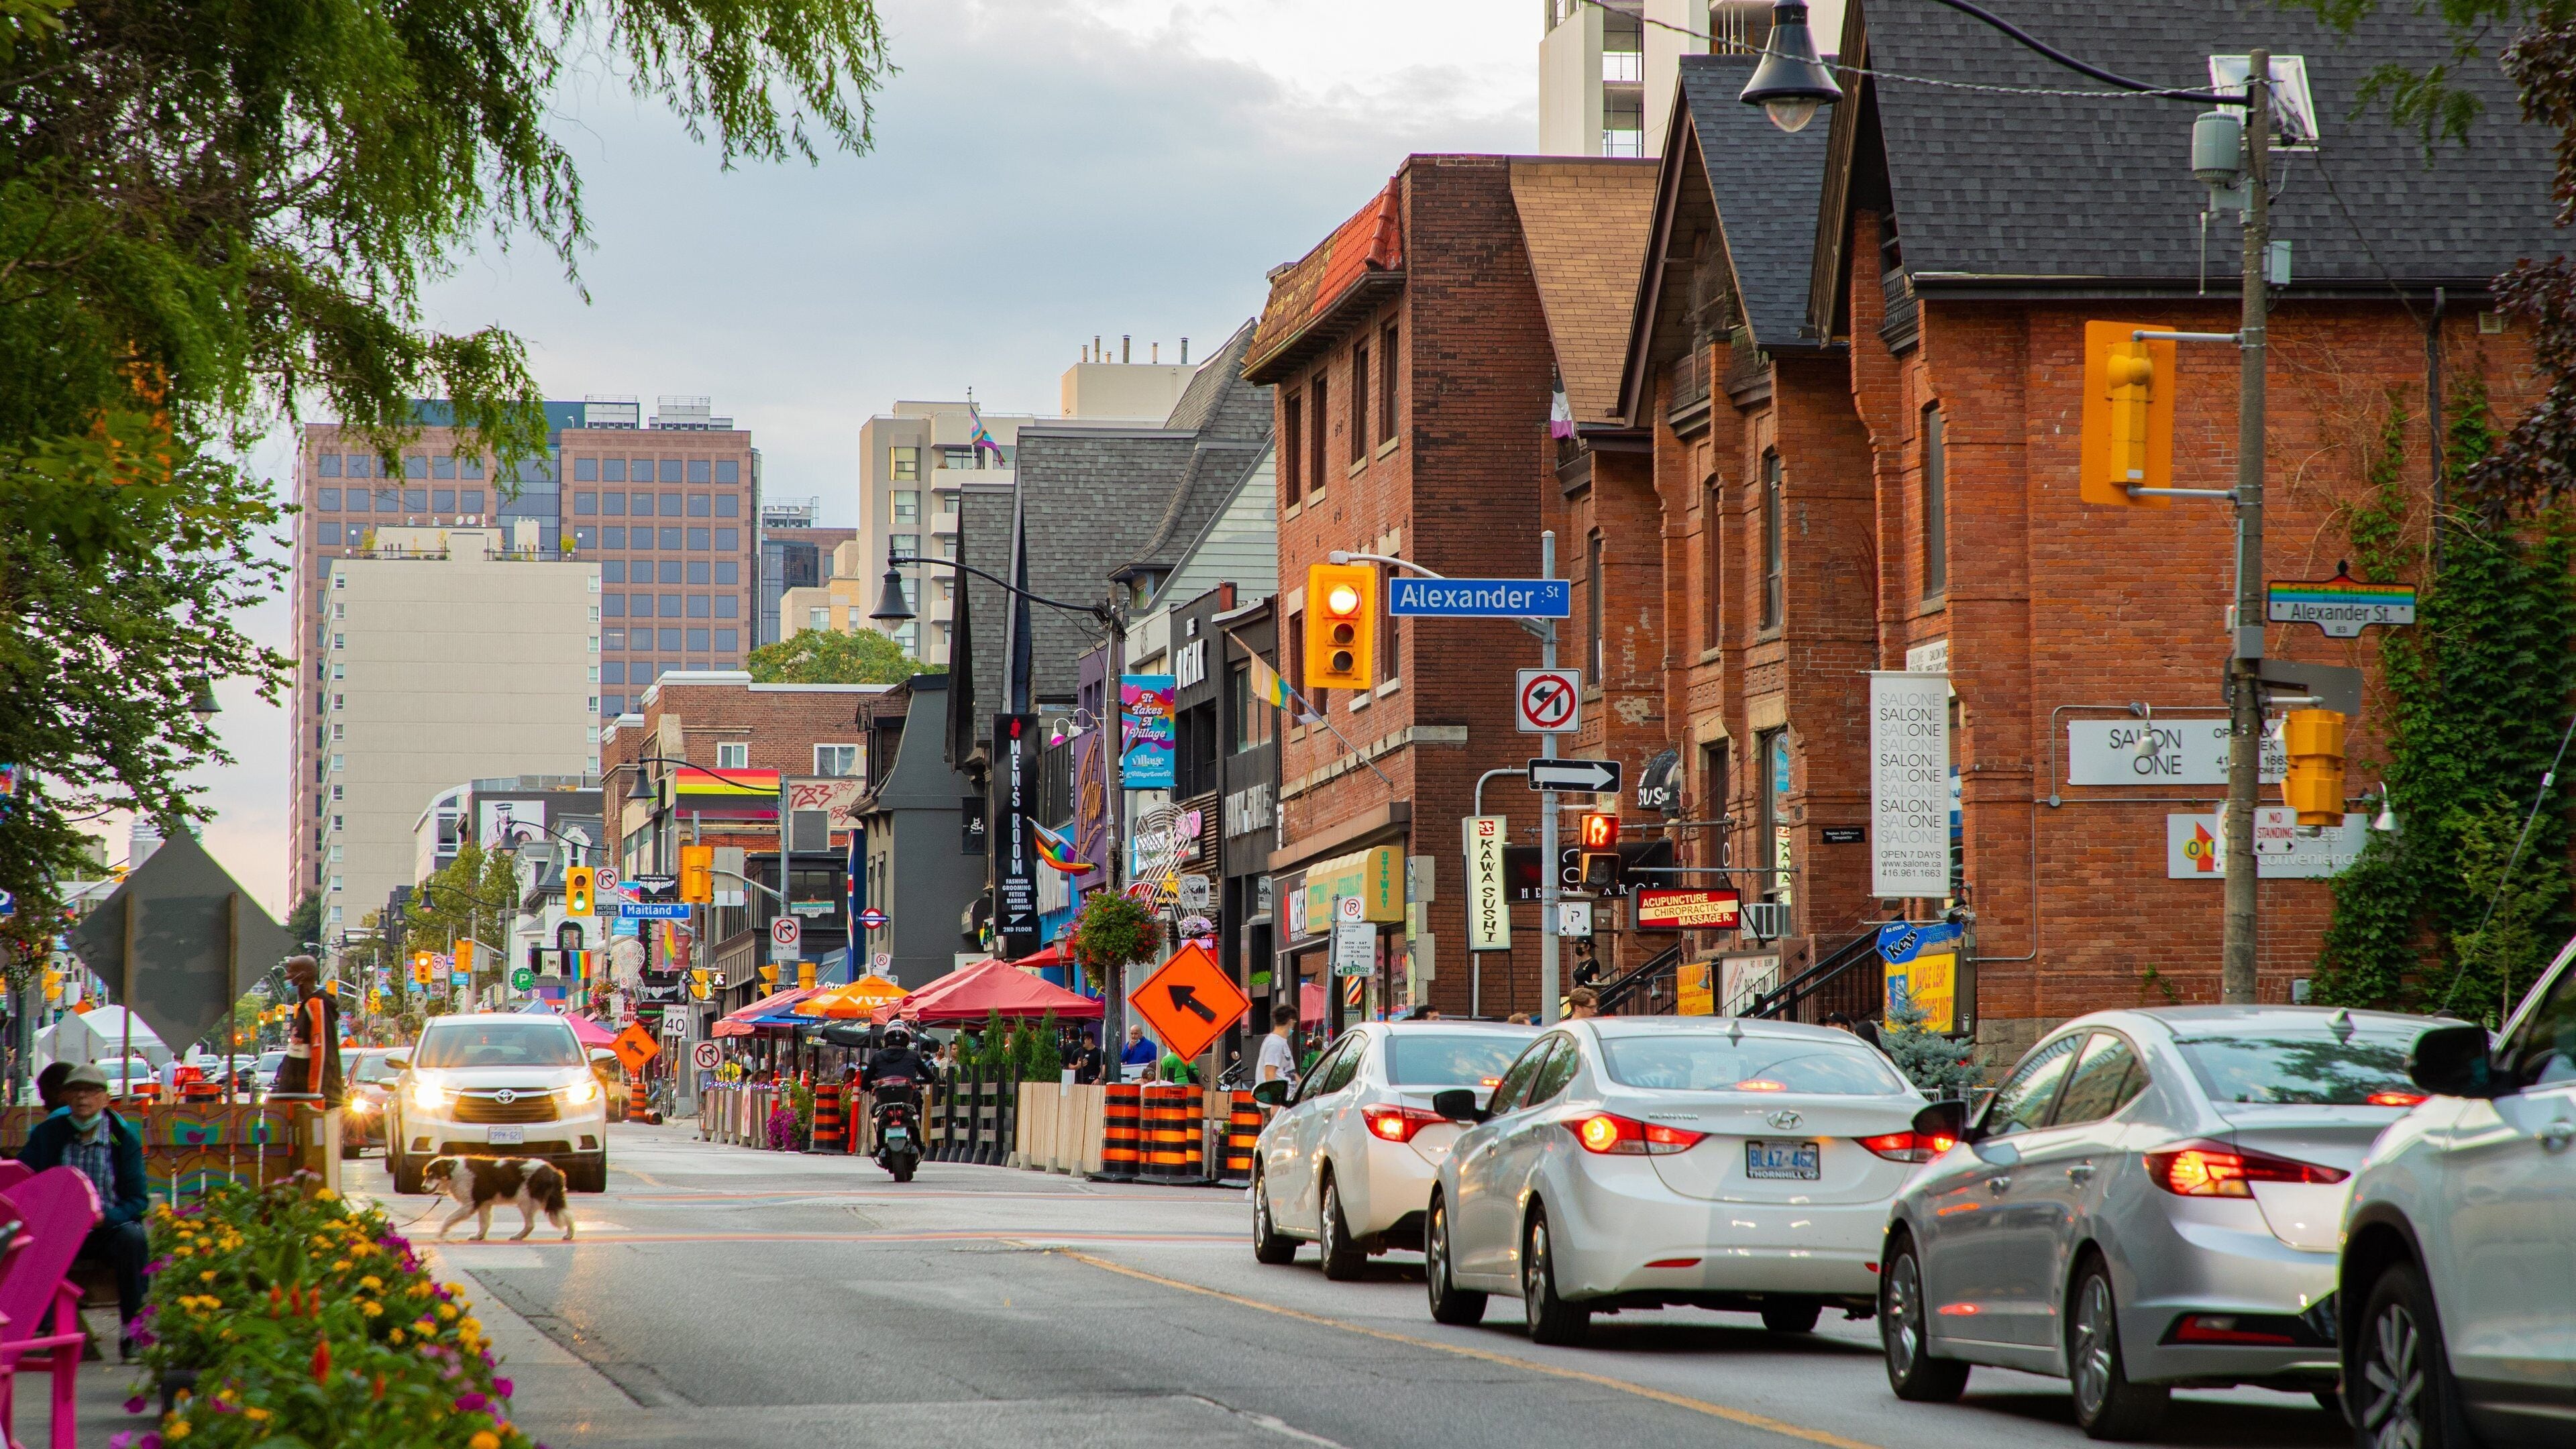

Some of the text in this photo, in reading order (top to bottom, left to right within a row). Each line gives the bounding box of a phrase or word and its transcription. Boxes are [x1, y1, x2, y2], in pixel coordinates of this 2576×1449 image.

[1399, 584, 1559, 608] Alexander St
[2290, 603, 2394, 622] Alexander St.
[1142, 693, 1154, 703] It
[1880, 692, 1941, 706] SALONE
[1132, 702, 1163, 715] Takes
[1880, 708, 1941, 721] SALONE
[1142, 716, 1153, 727] A
[1129, 727, 1167, 741] Village
[1880, 723, 1941, 736] SALONE
[1880, 739, 1941, 751] SALONE
[1880, 753, 1941, 767] SALONE
[2133, 755, 2182, 775] ONE
[1880, 769, 1941, 782] SALONE
[1880, 784, 1941, 798] SALONE
[1880, 800, 1941, 812] SALONE
[1880, 814, 1941, 828] SALONE
[2269, 812, 2282, 823] NO
[1880, 830, 1941, 843] SALONE
[2257, 827, 2294, 839] STANDING
[1012, 812, 1022, 875] ROOM
[1881, 850, 1941, 859] OPEN 7 DAYS
[1882, 869, 1941, 877] 416.961.1663
[660, 880, 676, 889] SHOP
[1480, 839, 1497, 943] KAWA SUSHI
[1642, 893, 1709, 908] ACUPUNCTURE
[627, 904, 672, 915] Maitland
[1654, 903, 1719, 917] CHIROPRACTIC
[1678, 913, 1722, 926] MASSAGE
[1885, 928, 1919, 961] Keys
[663, 984, 678, 994] SHOP
[665, 1018, 685, 1032] 40
[1748, 1170, 1804, 1179] THORNHILL
